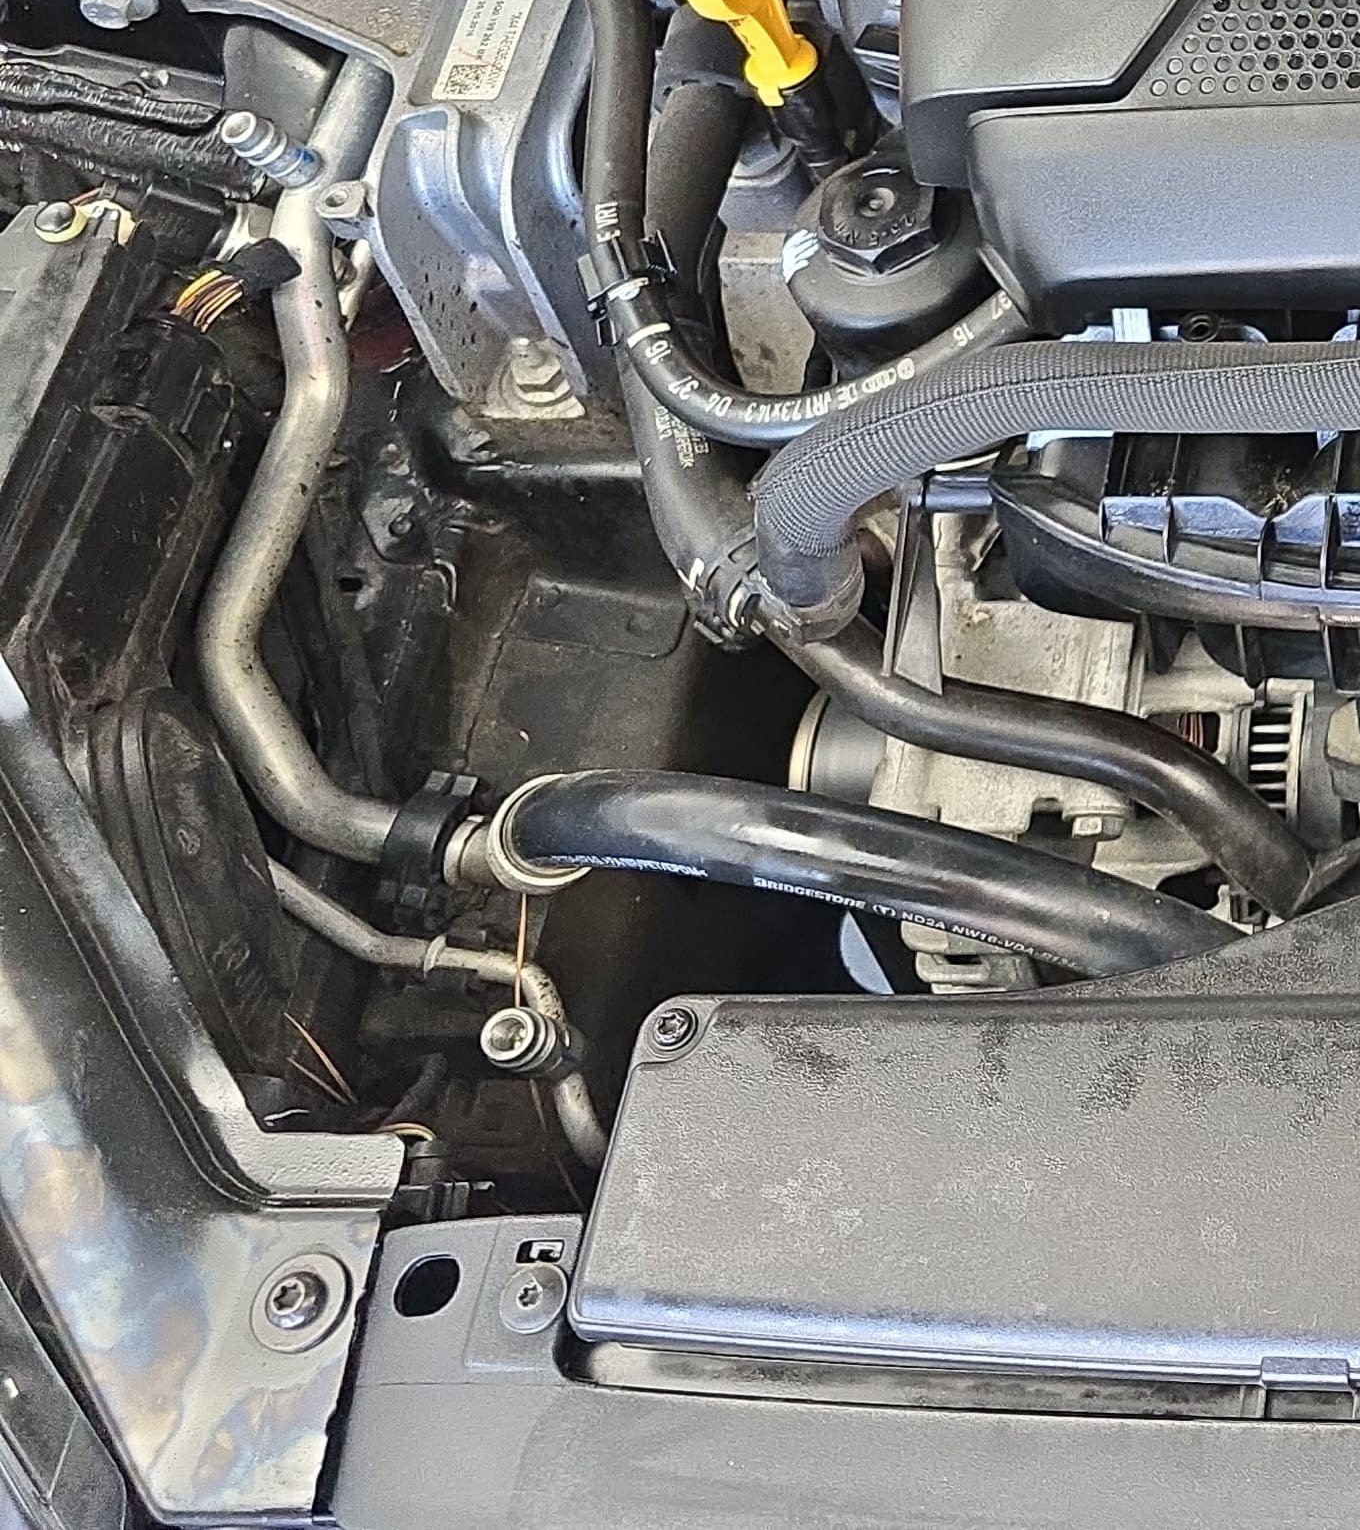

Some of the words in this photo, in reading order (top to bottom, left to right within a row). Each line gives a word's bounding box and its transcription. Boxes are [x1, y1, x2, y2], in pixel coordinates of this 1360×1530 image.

[645, 340, 672, 365] 16
[668, 376, 700, 401] 37
[837, 383, 859, 409] DE
[705, 392, 733, 417] 04
[753, 876, 865, 909] BRIDGESTONE
